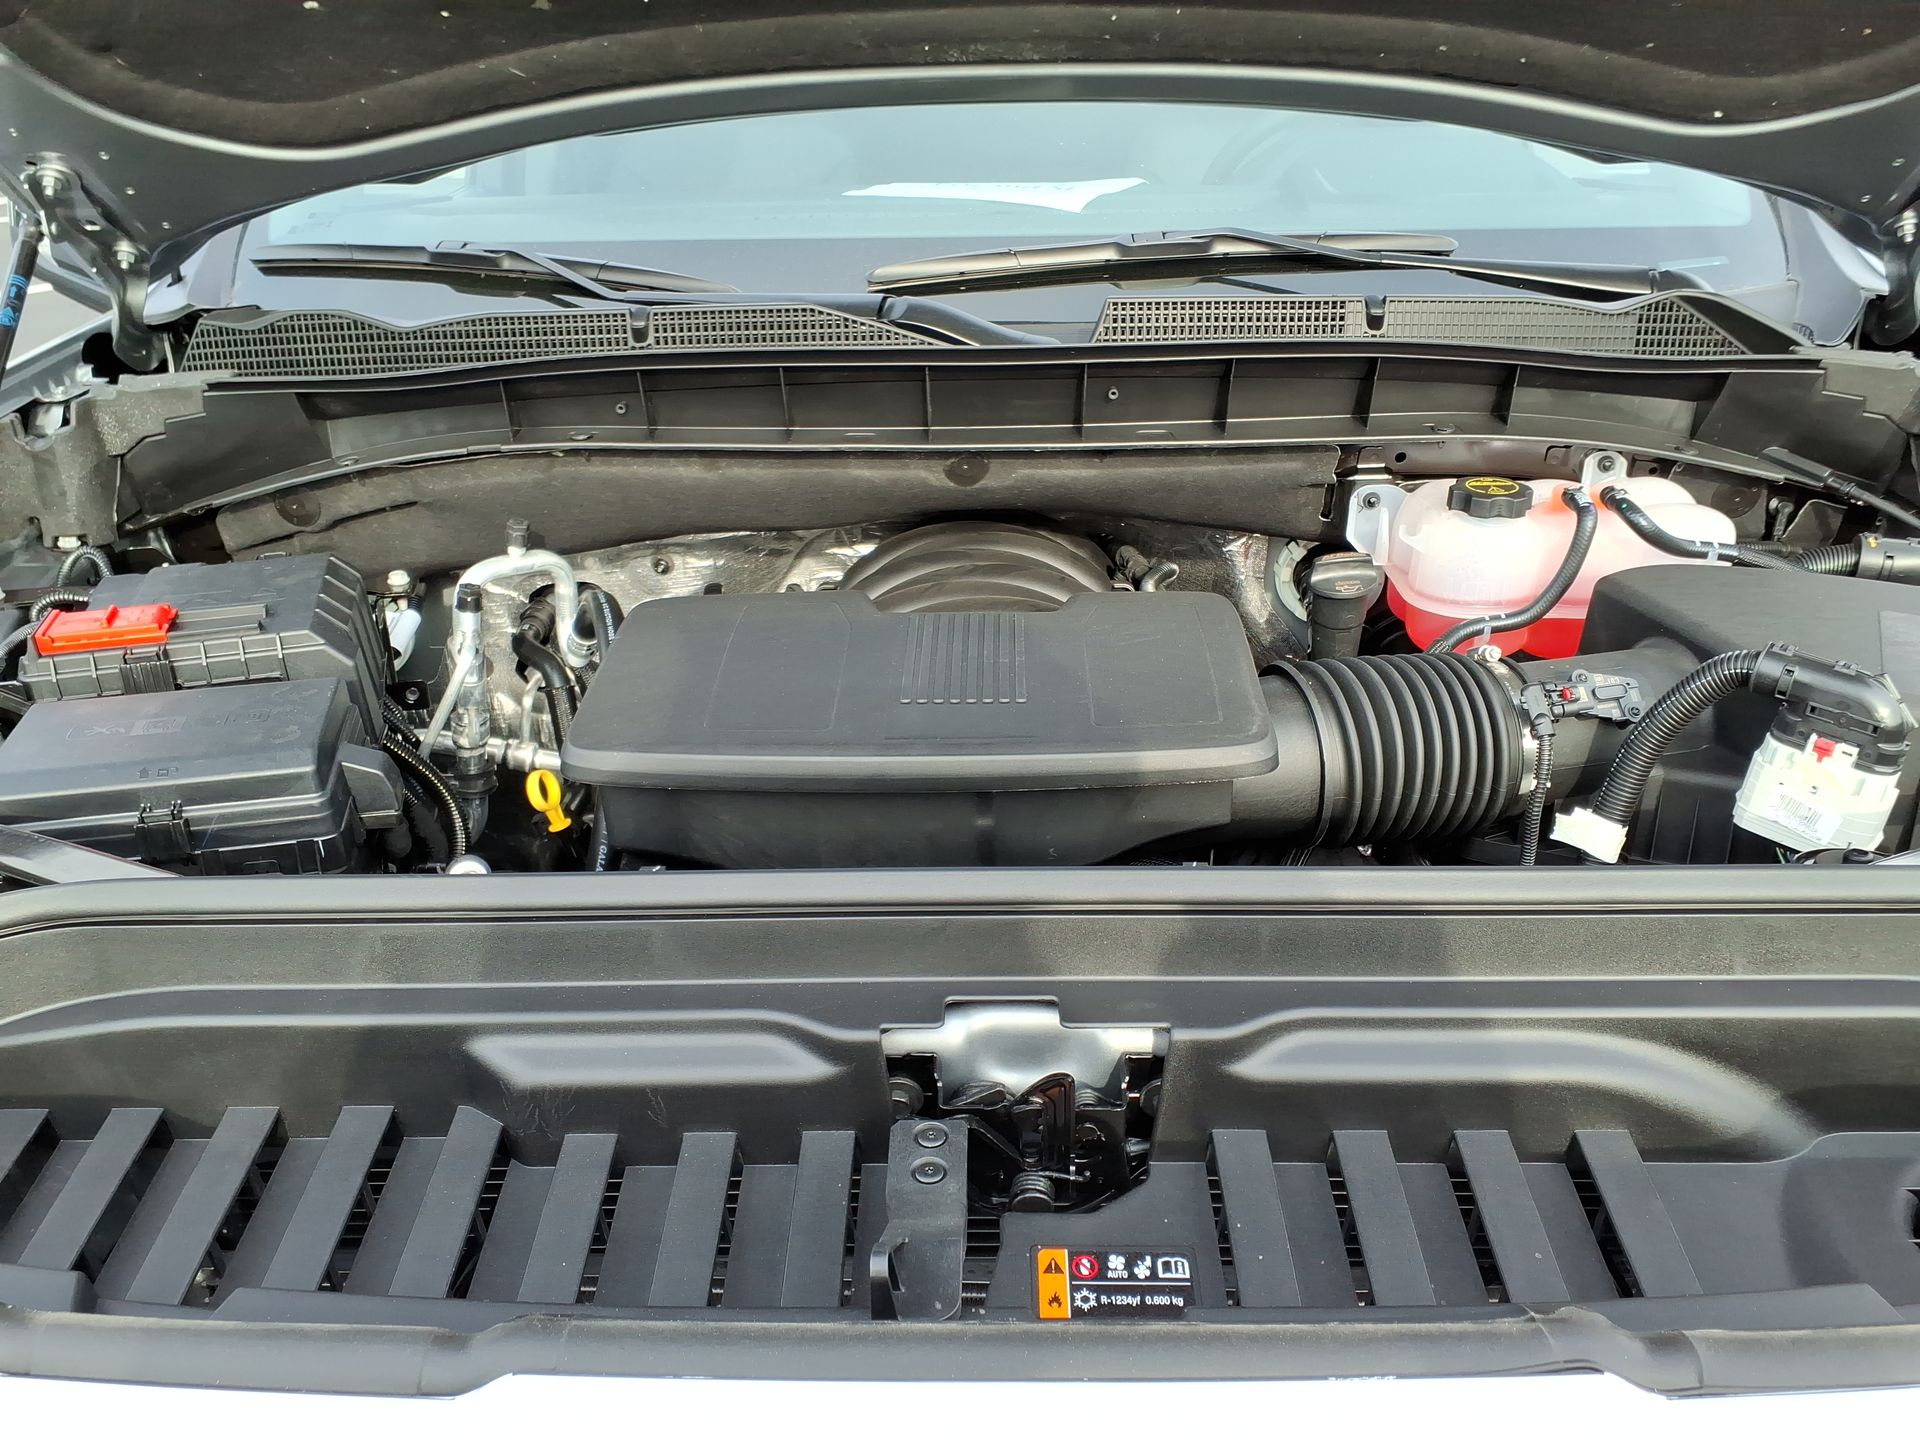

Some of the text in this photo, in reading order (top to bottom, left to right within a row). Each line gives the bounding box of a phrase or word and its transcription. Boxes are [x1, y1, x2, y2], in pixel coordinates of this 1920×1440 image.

[1107, 1270, 1128, 1279] AUTO
[1100, 1295, 1184, 1306] R-1234yf 0.600 kg
